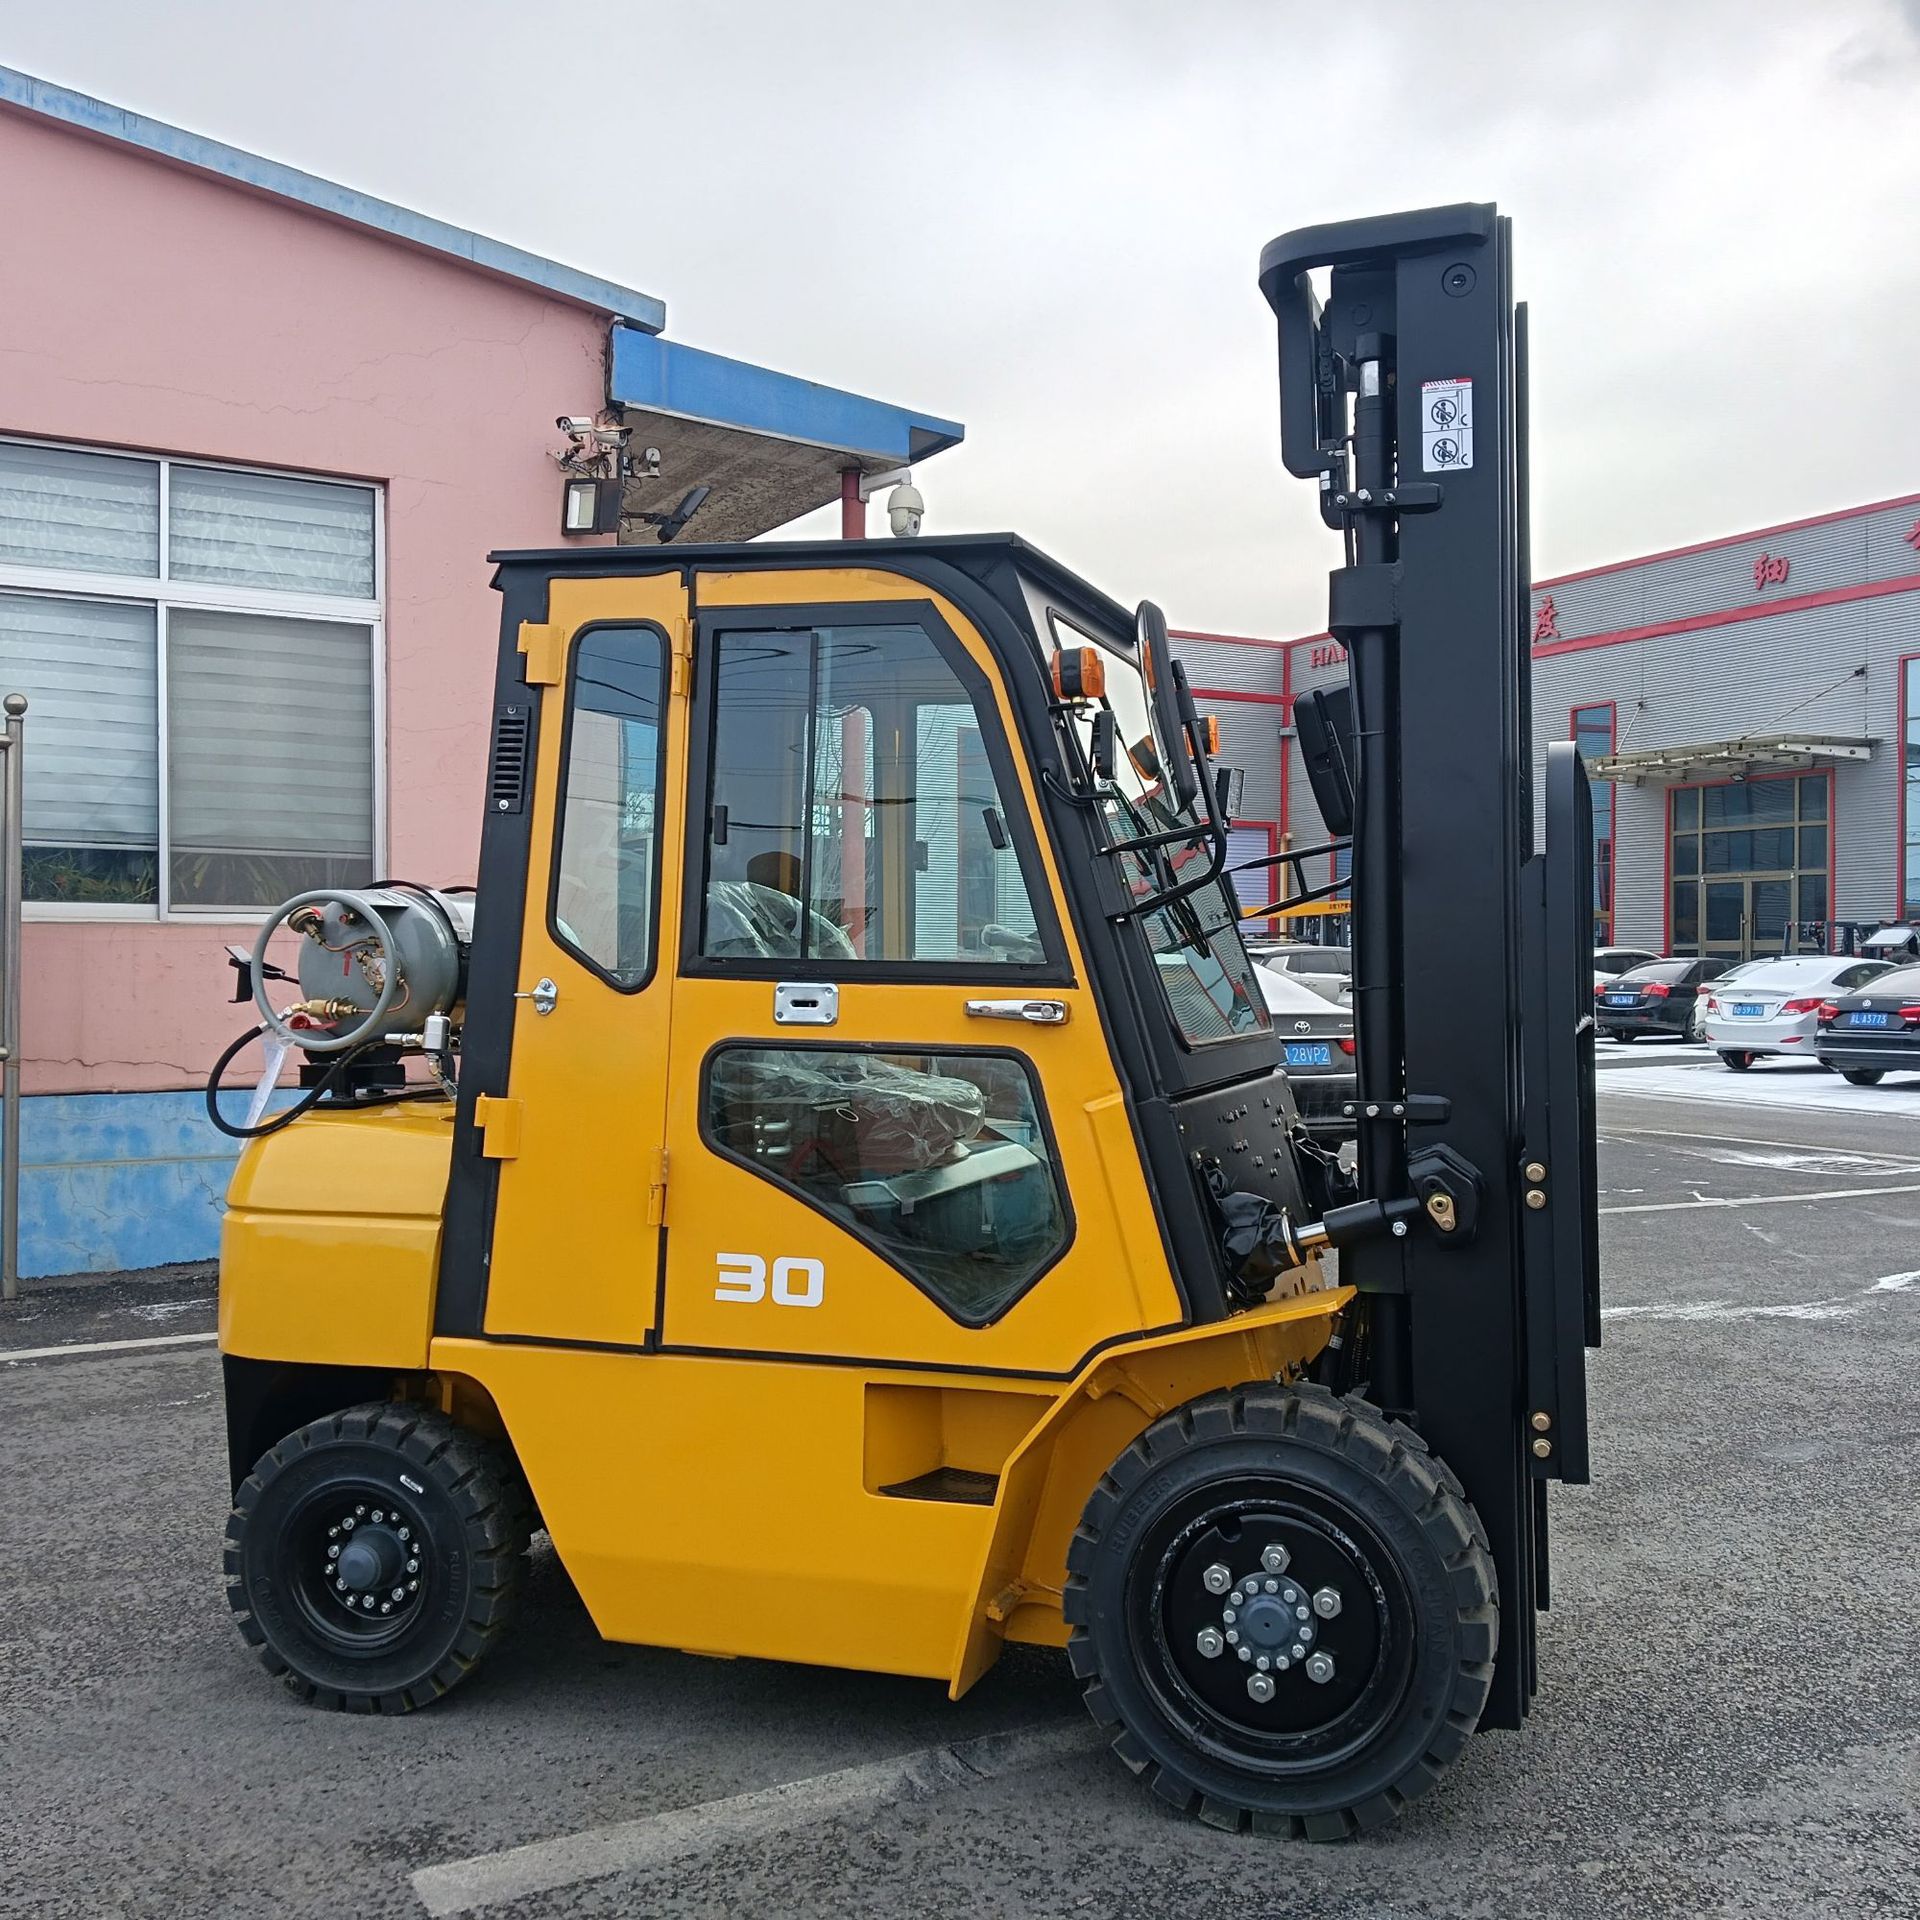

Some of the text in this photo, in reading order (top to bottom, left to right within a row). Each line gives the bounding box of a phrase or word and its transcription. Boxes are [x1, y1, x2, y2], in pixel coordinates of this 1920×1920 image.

[1533, 595, 1560, 643] 度
[1311, 645, 1347, 668] HA
[715, 1252, 825, 1308] 30
